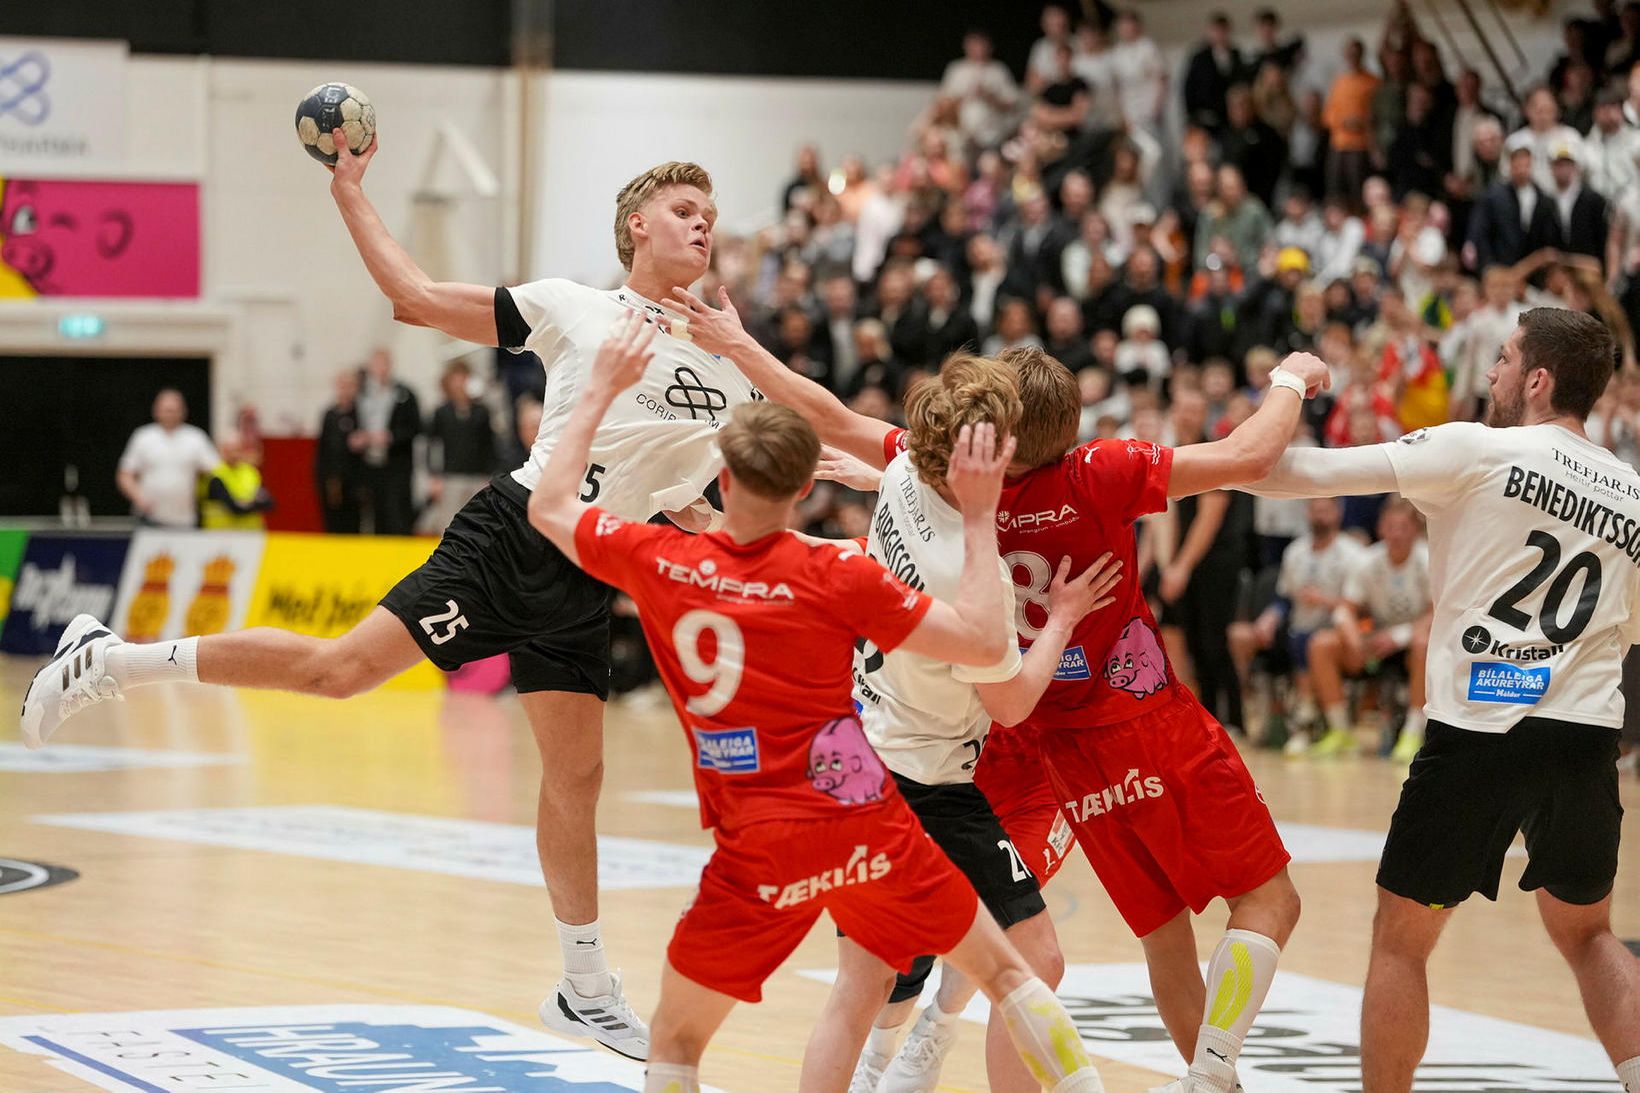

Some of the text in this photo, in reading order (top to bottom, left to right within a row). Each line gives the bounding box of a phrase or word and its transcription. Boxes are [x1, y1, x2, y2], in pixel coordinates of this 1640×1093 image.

[995, 504, 1078, 532] MPRA
[655, 556, 795, 600] TEMPRA
[1488, 530, 1602, 644] 20
[419, 599, 469, 645] 25
[672, 609, 745, 717] 9
[1490, 640, 1564, 660] Kristall
[1475, 679, 1545, 690] AKUREYRAR
